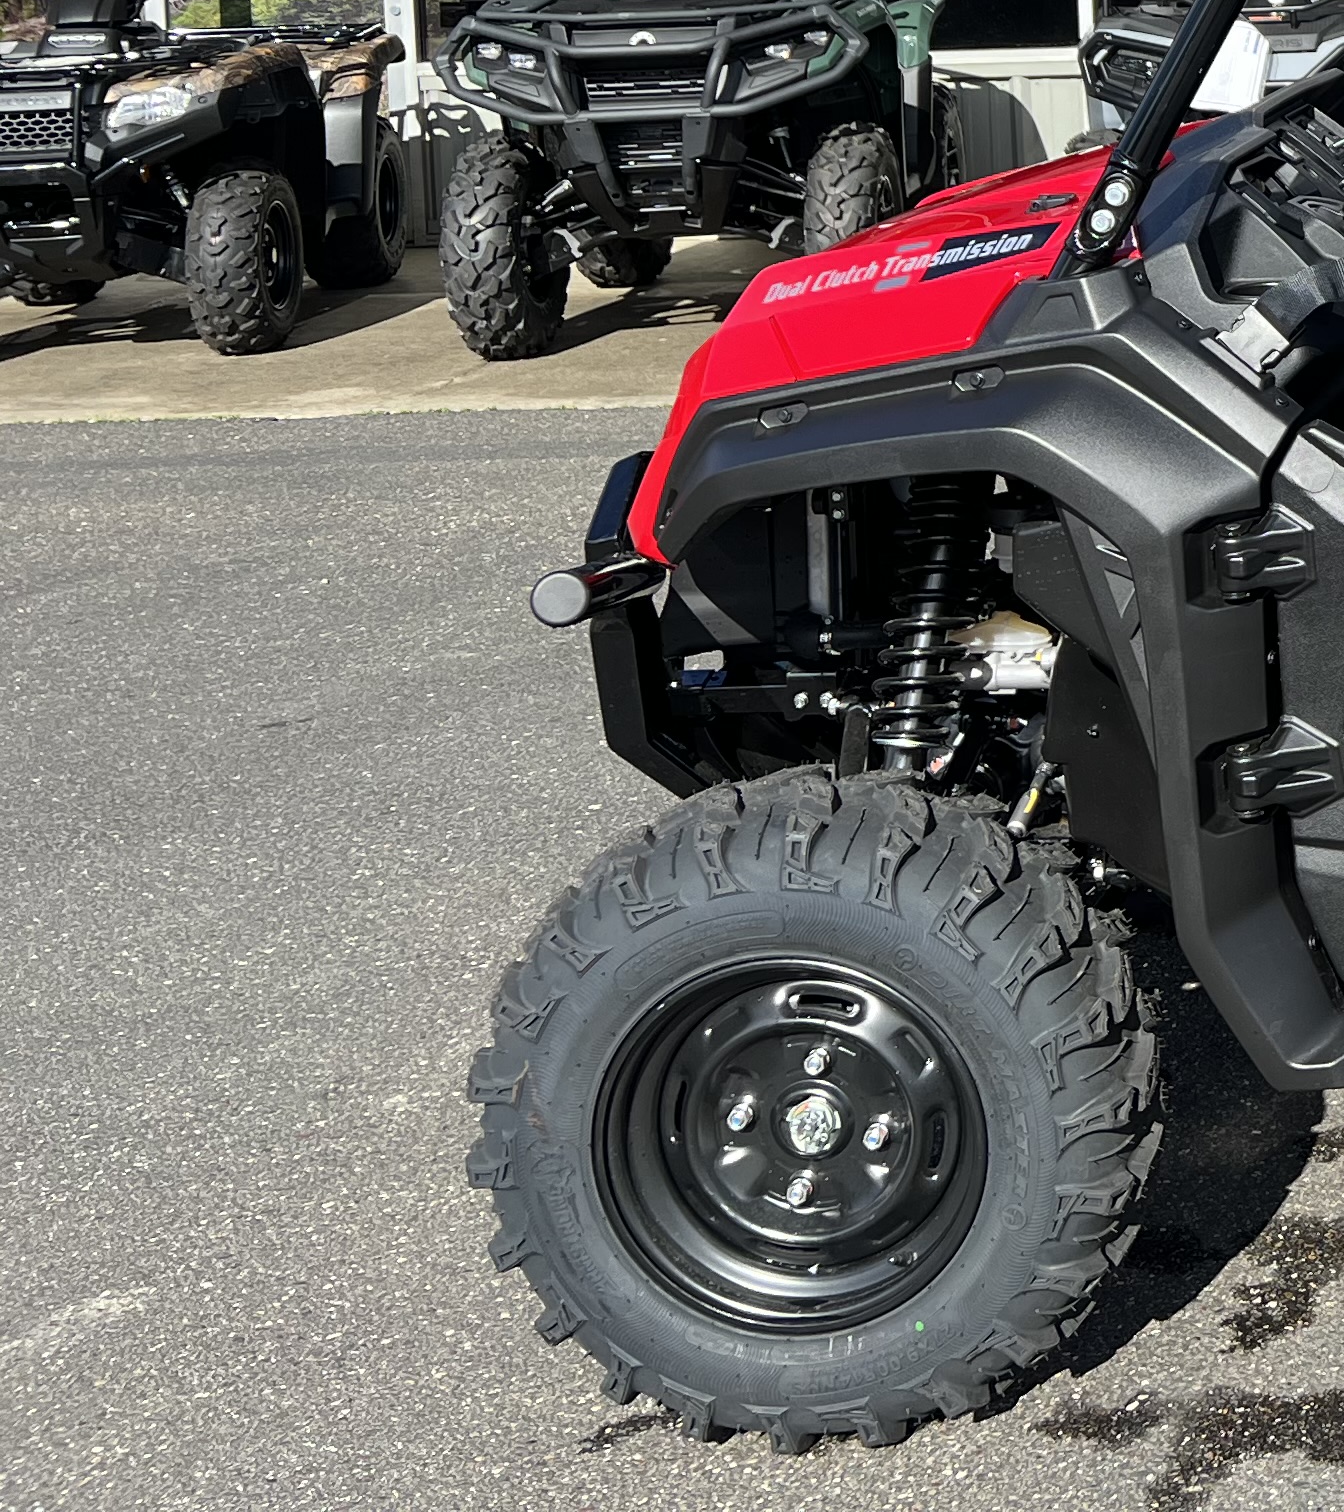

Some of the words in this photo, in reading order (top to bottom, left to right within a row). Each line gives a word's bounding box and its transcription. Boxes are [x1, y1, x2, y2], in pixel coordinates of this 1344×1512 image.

[762, 274, 806, 304] Dual
[811, 260, 879, 293] Clutch
[881, 232, 1034, 277] Transmission
[919, 969, 993, 1036] DIRT
